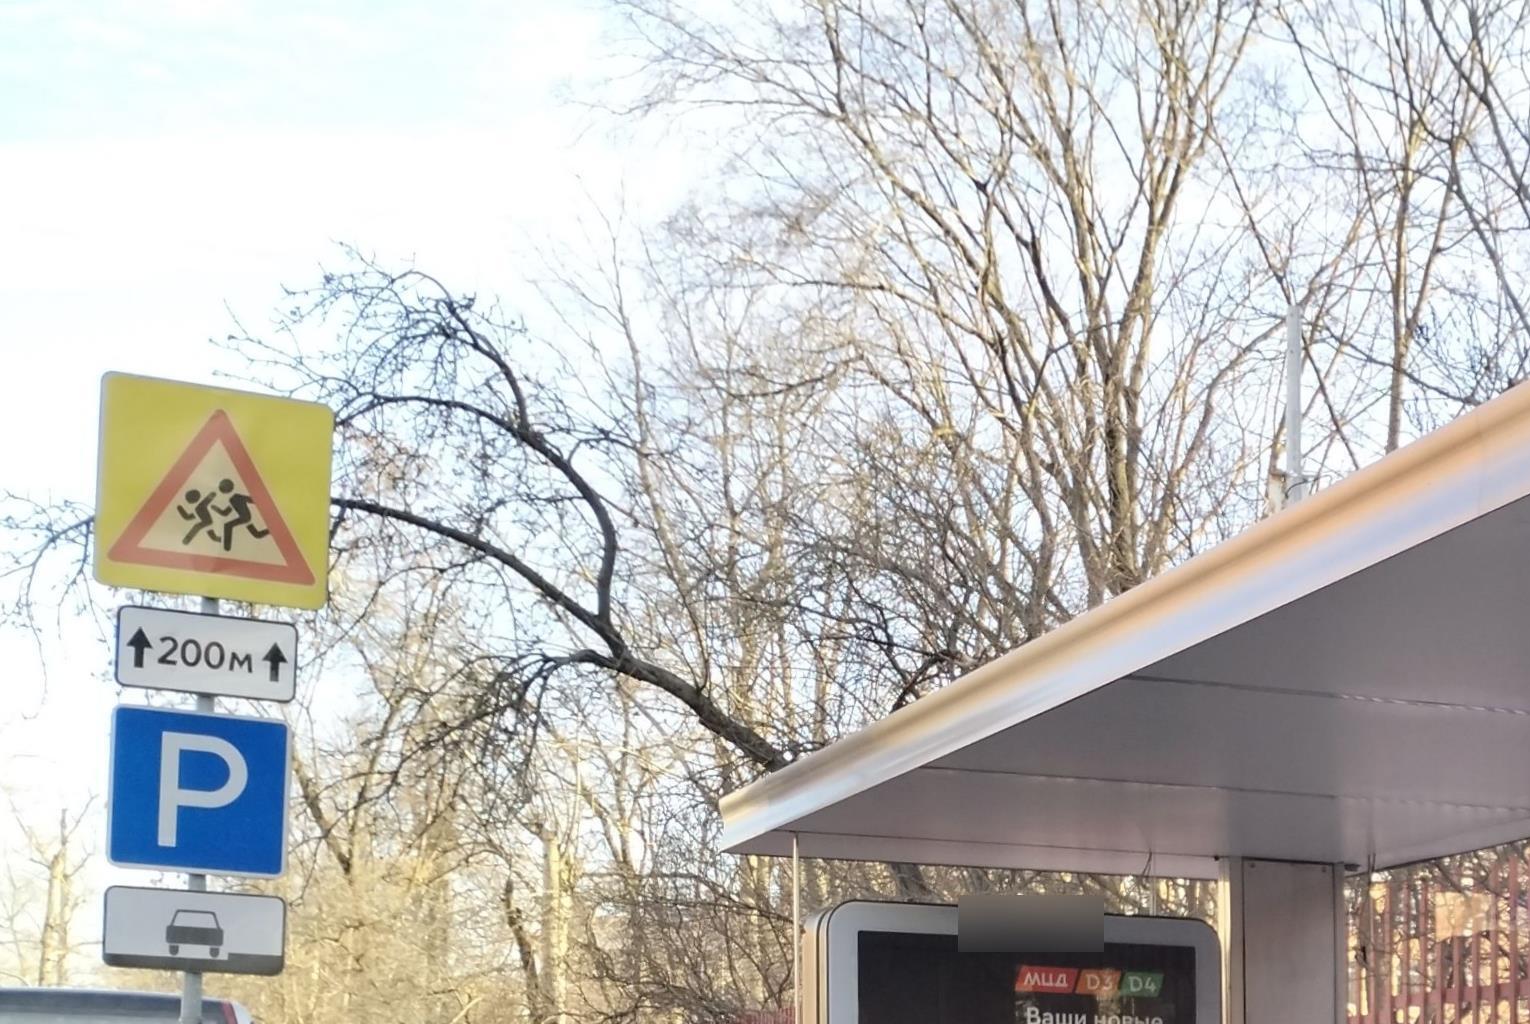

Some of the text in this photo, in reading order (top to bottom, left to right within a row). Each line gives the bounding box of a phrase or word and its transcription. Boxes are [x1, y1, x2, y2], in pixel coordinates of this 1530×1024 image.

[157, 730, 249, 848] P
[1086, 974, 1113, 991] D3
[1128, 976, 1157, 993] D4
